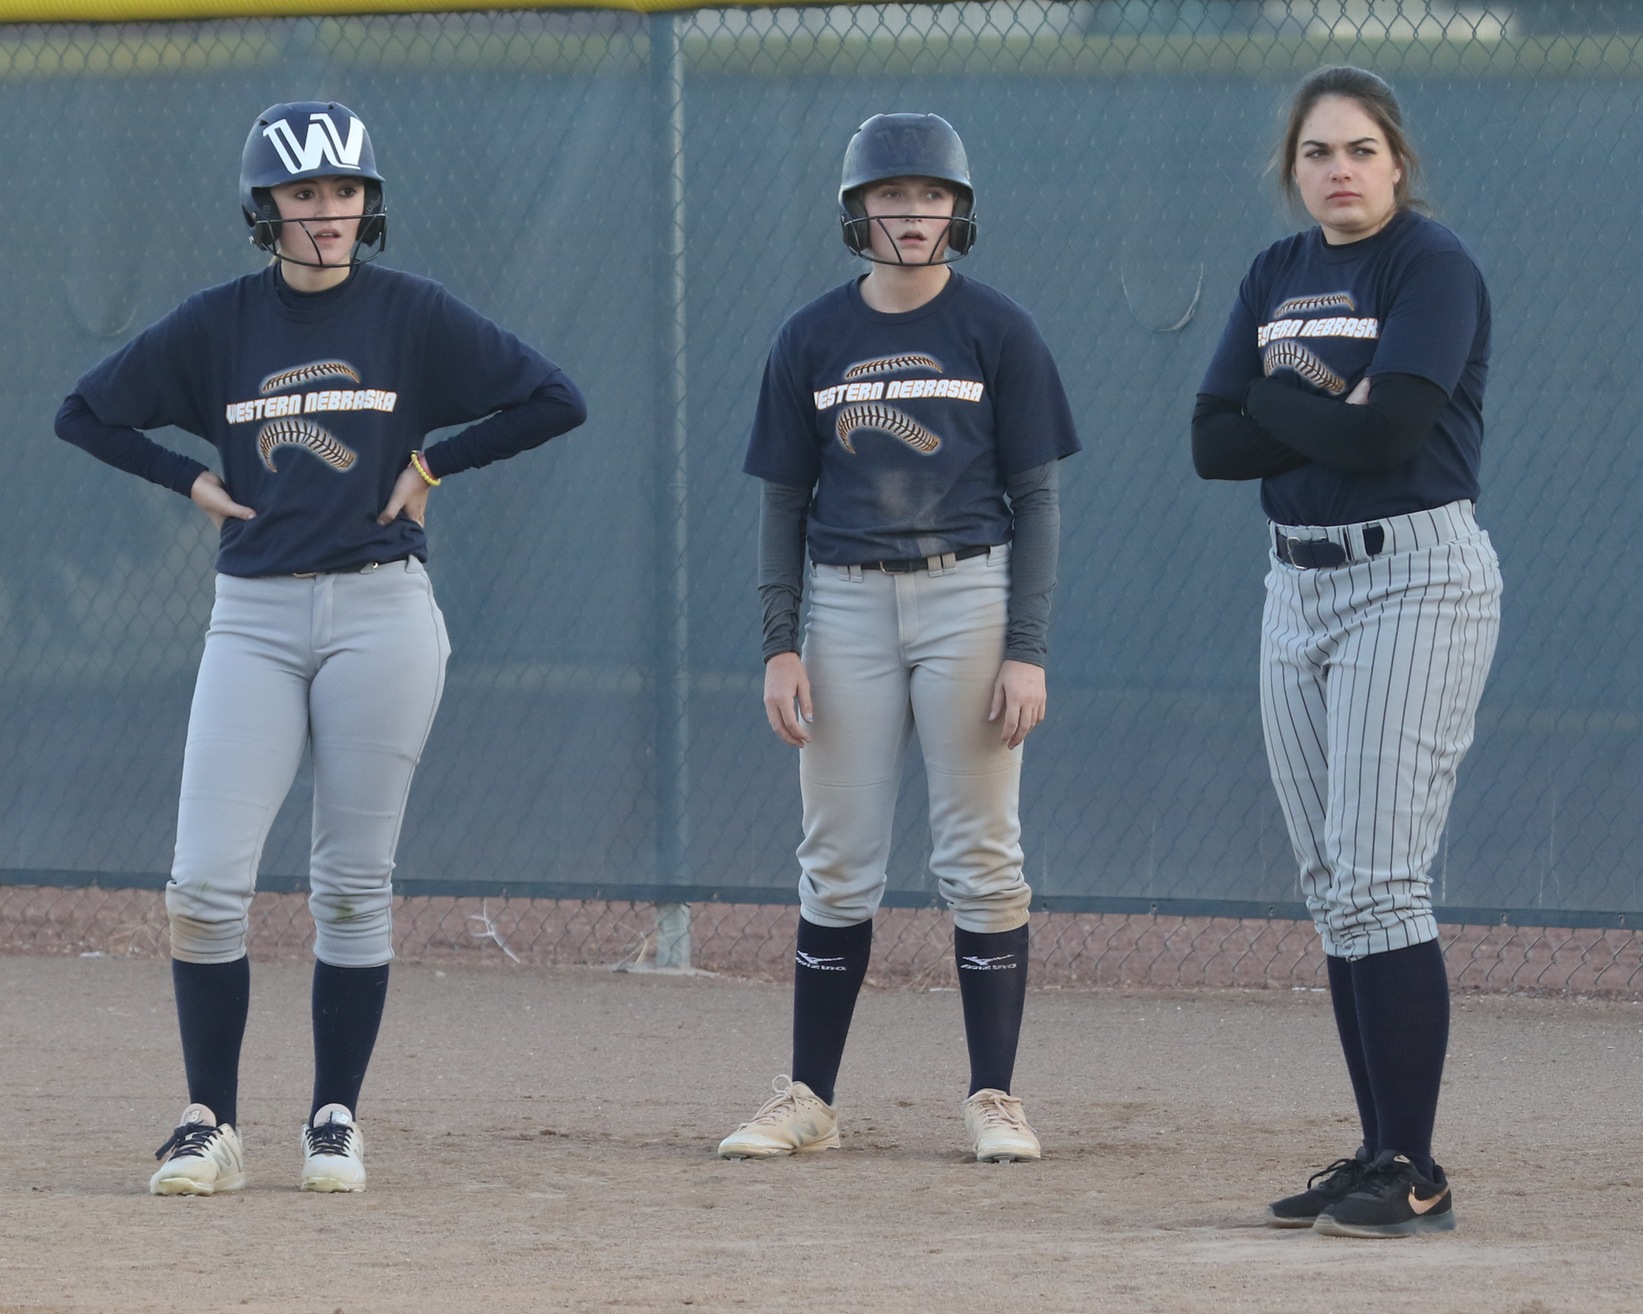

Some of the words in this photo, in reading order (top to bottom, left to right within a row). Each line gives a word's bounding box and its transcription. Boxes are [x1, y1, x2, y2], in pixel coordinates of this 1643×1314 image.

[262, 113, 365, 174] W
[1257, 319, 1303, 347] ESTERN
[1298, 316, 1379, 339] NEBRASK
[226, 394, 302, 424] WESTERN
[304, 389, 397, 413] NEBRASKA
[885, 379, 984, 402] NEBRASKA
